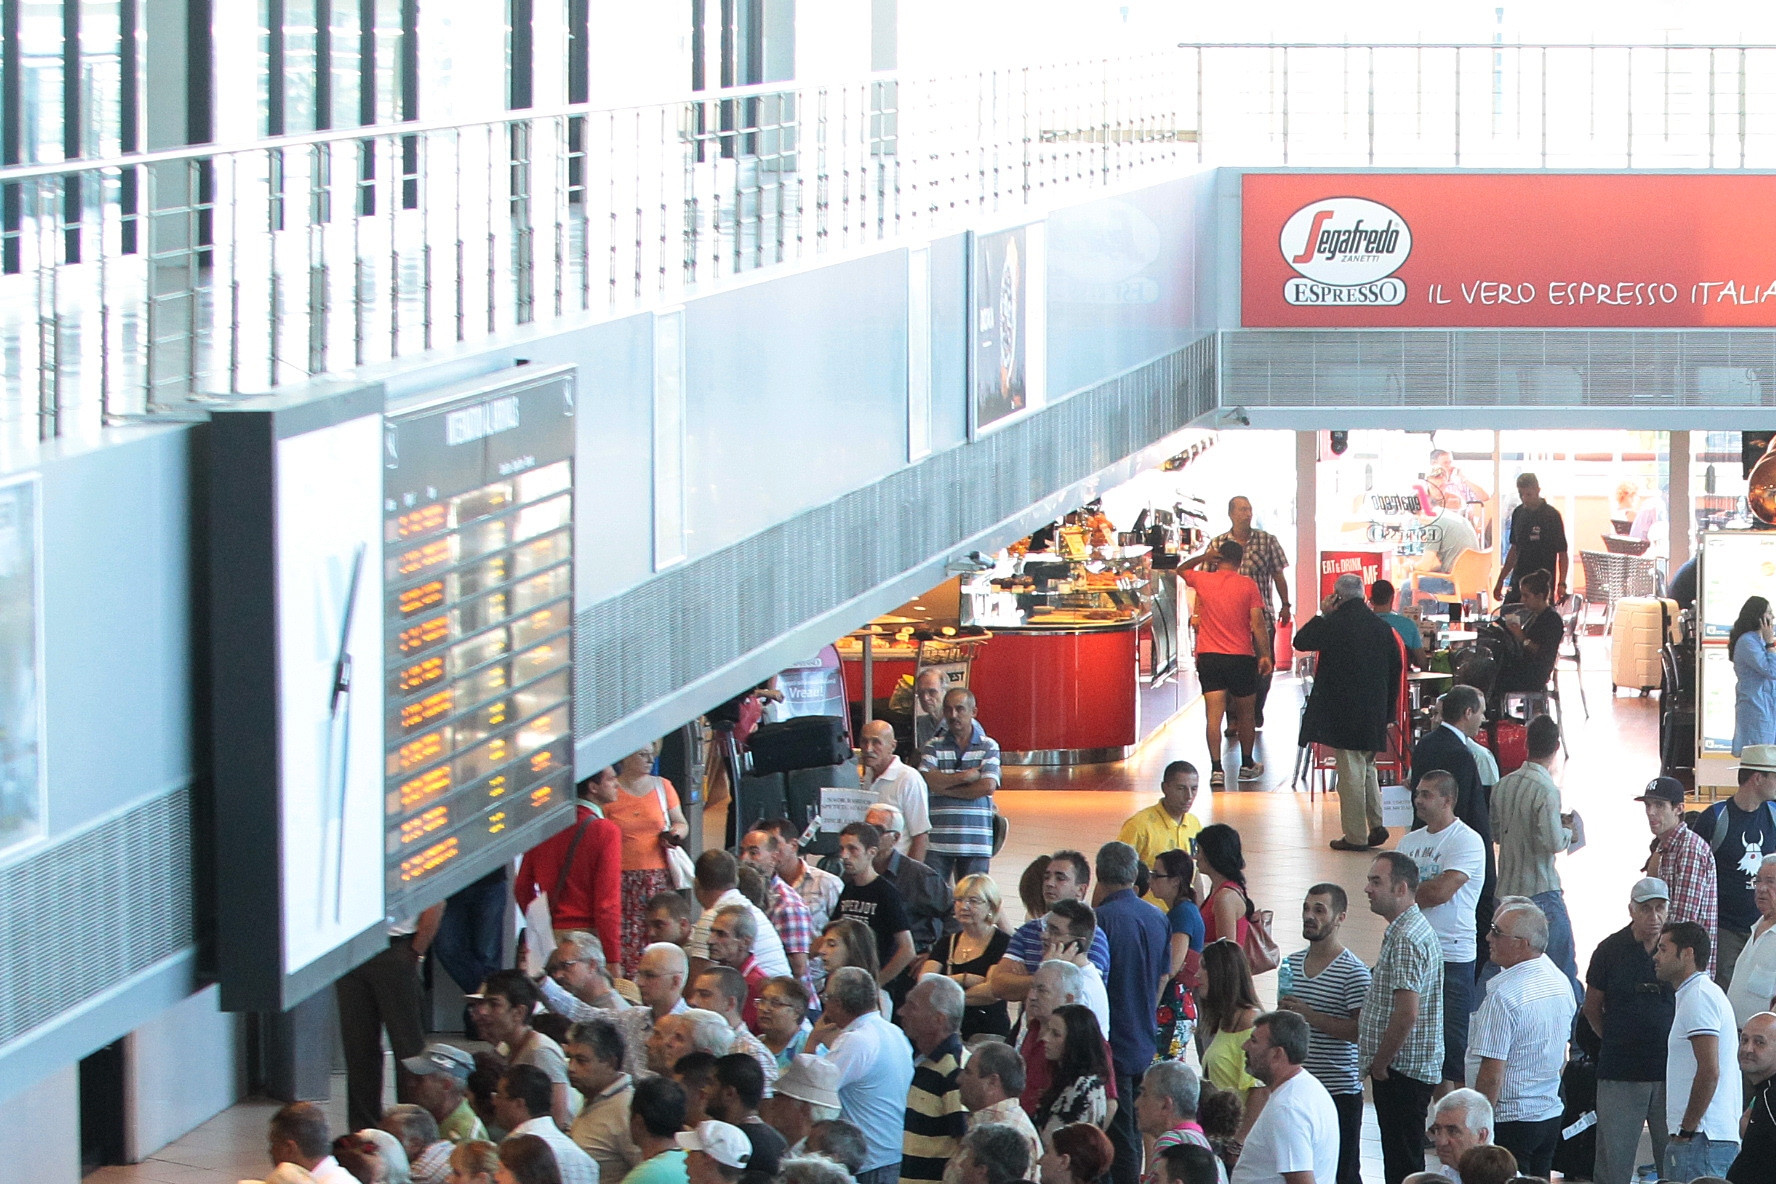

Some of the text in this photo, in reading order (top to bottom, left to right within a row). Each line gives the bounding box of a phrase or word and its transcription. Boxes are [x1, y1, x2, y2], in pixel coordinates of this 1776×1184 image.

[1292, 210, 1400, 264] Segafredo
[1341, 255, 1380, 263] ZANETTI
[1293, 281, 1397, 303] ESPRESSO
[1428, 283, 1452, 304] IL
[1461, 280, 1535, 305] VERO
[1549, 281, 1678, 305] ESPRESSO
[1322, 559, 1335, 574] EAT
[1340, 557, 1363, 573] DRINK
